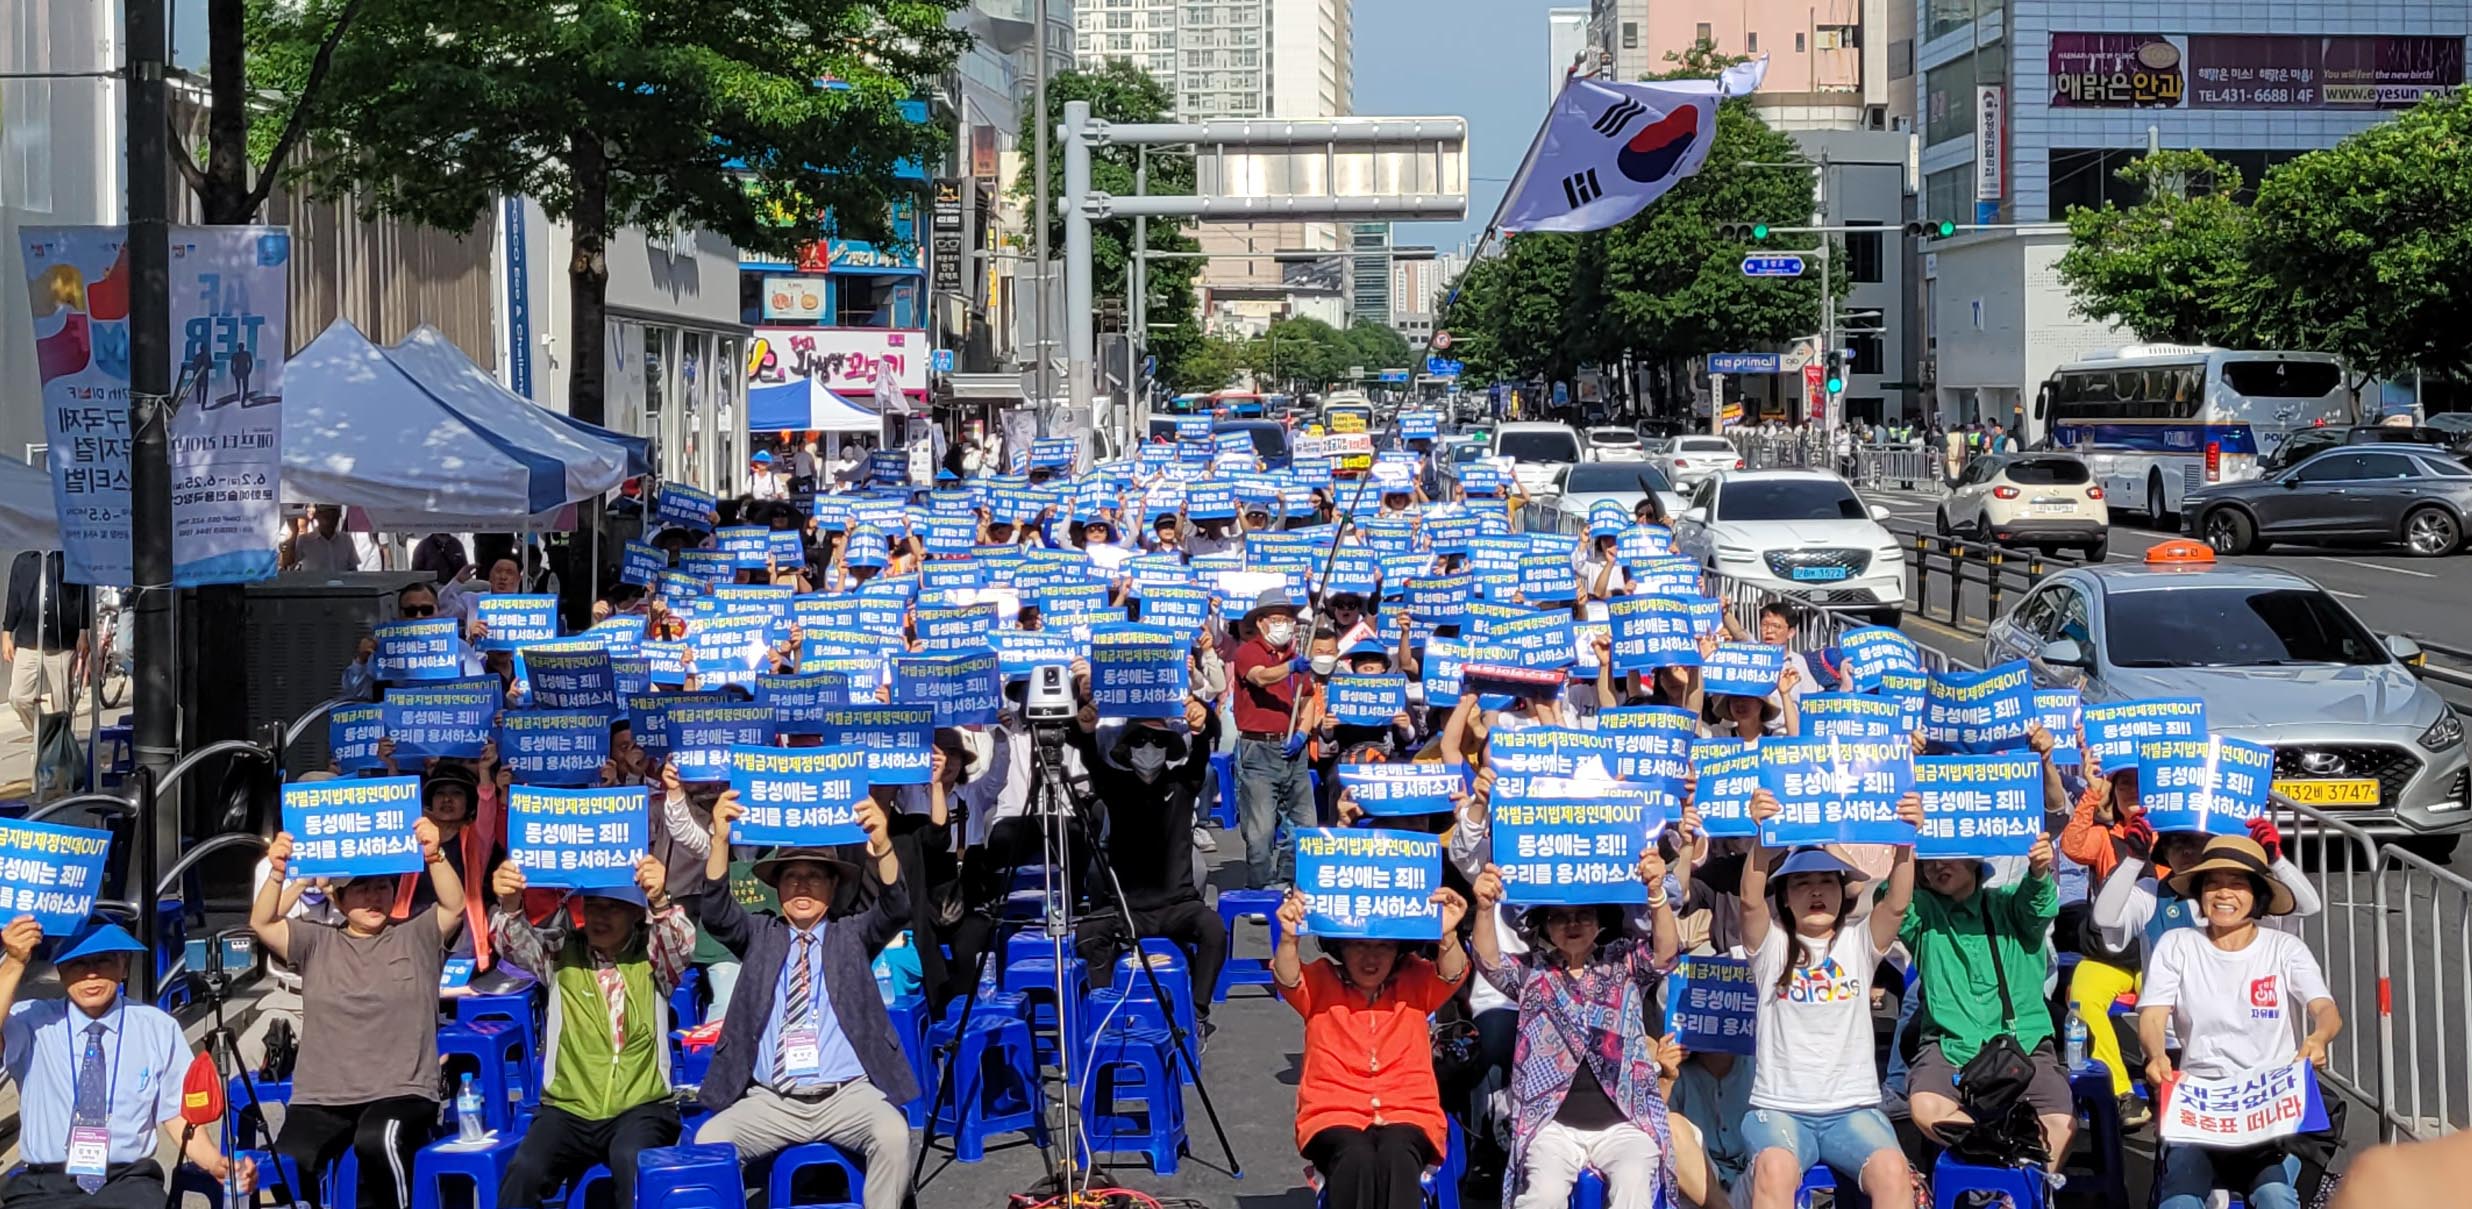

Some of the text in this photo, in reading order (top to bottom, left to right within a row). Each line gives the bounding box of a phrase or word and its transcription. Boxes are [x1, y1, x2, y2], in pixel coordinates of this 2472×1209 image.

[2199, 68, 2229, 80] 해맑은
[2259, 68, 2288, 81] 해맑은
[2323, 69, 2339, 80] You
[2356, 70, 2374, 80] feel
[2375, 70, 2390, 80] the
[2392, 72, 2408, 80] new
[2057, 73, 2183, 101] 해맑은안과
[2275, 364, 2285, 376] 4
[929, 621, 989, 636] 동성애는 죄!!
[1624, 618, 1669, 635] 동성애는
[385, 639, 447, 654] 동성애는 죄!!
[921, 639, 947, 649] 우리를
[1615, 640, 1645, 655] 우리를
[378, 655, 457, 669] 우리를 용서하소서
[1094, 651, 1184, 662] 차별금지법제정연대OUT
[900, 660, 996, 676] 차별금지법제정연대OUT
[1104, 669, 1178, 684] 동성애는 죄!!
[915, 678, 987, 696] 동성애는 죄!!
[387, 693, 491, 706] 차별금지법제정연대OUT
[942, 697, 998, 714] 용서하소서
[1094, 690, 1187, 704] 우리를 용서하소서
[1340, 691, 1395, 702] 동성애는 죄!!
[402, 711, 479, 725] 동성애는 죄!!
[667, 707, 774, 722] 차별금지법제정연대OUT
[1331, 704, 1356, 716] 우리를
[1930, 697, 2021, 724] 동성애는 죄!!
[2085, 703, 2203, 720] 차별금지법제정연대OUT
[505, 715, 609, 730] 차별금지법제정연대OUT
[1964, 718, 2033, 743] 용서하소서
[2103, 721, 2191, 737] 동성애는 죄!!
[389, 728, 488, 744] 우리를 용서하소서
[519, 736, 596, 751] 동성애는 죄!!
[682, 729, 761, 745] 동성애는 죄!!
[1762, 743, 1908, 762] 차별금지법제정연대OUT
[2092, 739, 2132, 757] 우리를
[508, 756, 606, 771] 우리를 용서하소서
[672, 751, 704, 766] 우리를
[733, 752, 864, 772] 차별금지법제정연대OUT
[752, 781, 850, 801] 동성애는 죄!!
[1349, 779, 1459, 800] 우리를 용서하소서
[1784, 772, 1894, 793] 동성애는 죄!!
[2228, 775, 2254, 796] 죄!!
[286, 785, 416, 808] 차별금지법제정연대OUT
[1922, 790, 2025, 810] 동성애는 죄!!
[2328, 785, 2371, 800] 3747
[511, 793, 644, 815] 차별금지법제정연대OUT
[2143, 793, 2182, 813] 우리를
[305, 809, 404, 835] 동성애는 죄!!
[739, 808, 781, 826] 우리를
[1496, 806, 1642, 825] 차별금지법제정연대OUT
[1772, 803, 1820, 825] 우리를
[525, 823, 628, 844] 동성애는 죄!!
[1960, 815, 2040, 838] 용서하소서
[292, 833, 418, 862] 우리를 용서하소서
[1300, 837, 1438, 858] 차별금지법제정연대OUT
[1518, 834, 1627, 856] 동성애는 죄!!
[511, 851, 557, 869] 우리를
[60, 865, 87, 889] 죄!!
[1318, 867, 1425, 889] 동성애는 죄!!
[1501, 865, 1552, 884] 우리를
[16, 889, 90, 915] 용서하소서
[1305, 895, 1438, 917] 우리를 용서하소서
[1690, 988, 1757, 1010] 동성애는
[1672, 1013, 1718, 1035] 우리를
[2180, 1096, 2302, 1134] 홍준표 떠나라
